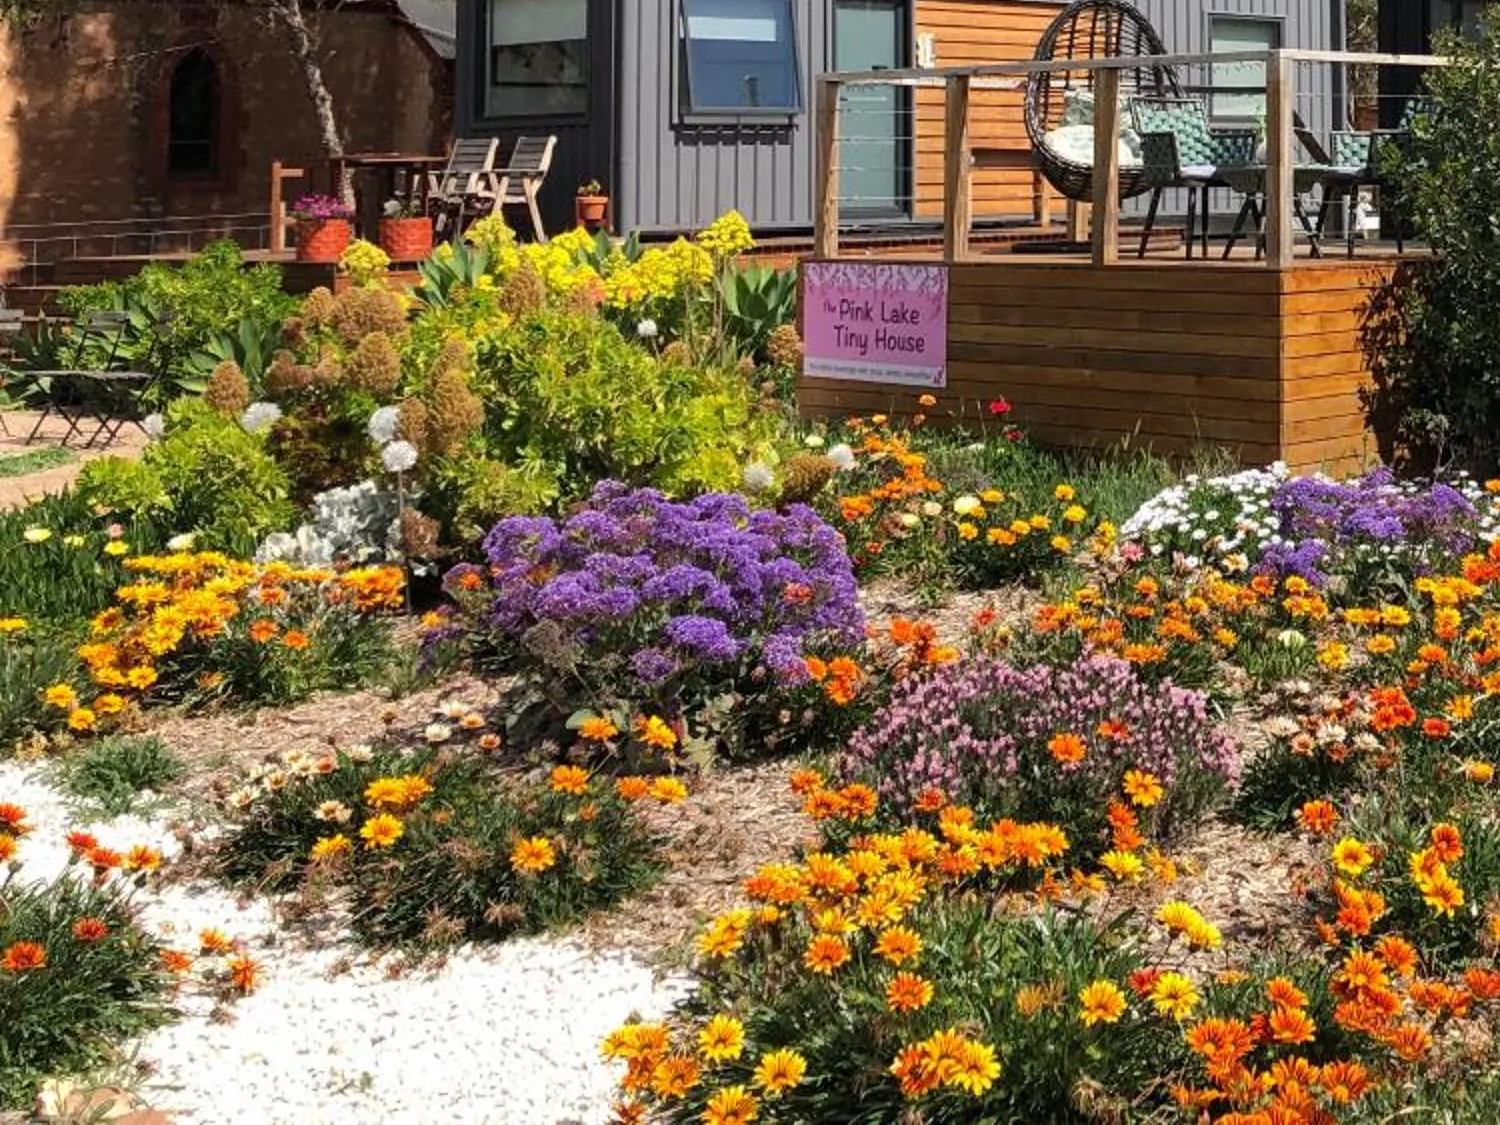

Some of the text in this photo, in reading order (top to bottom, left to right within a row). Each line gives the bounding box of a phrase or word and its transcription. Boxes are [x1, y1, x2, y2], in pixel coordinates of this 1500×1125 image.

[839, 298, 874, 323] Pink
[881, 300, 921, 325] Lake
[833, 324, 925, 356] Tiny House
